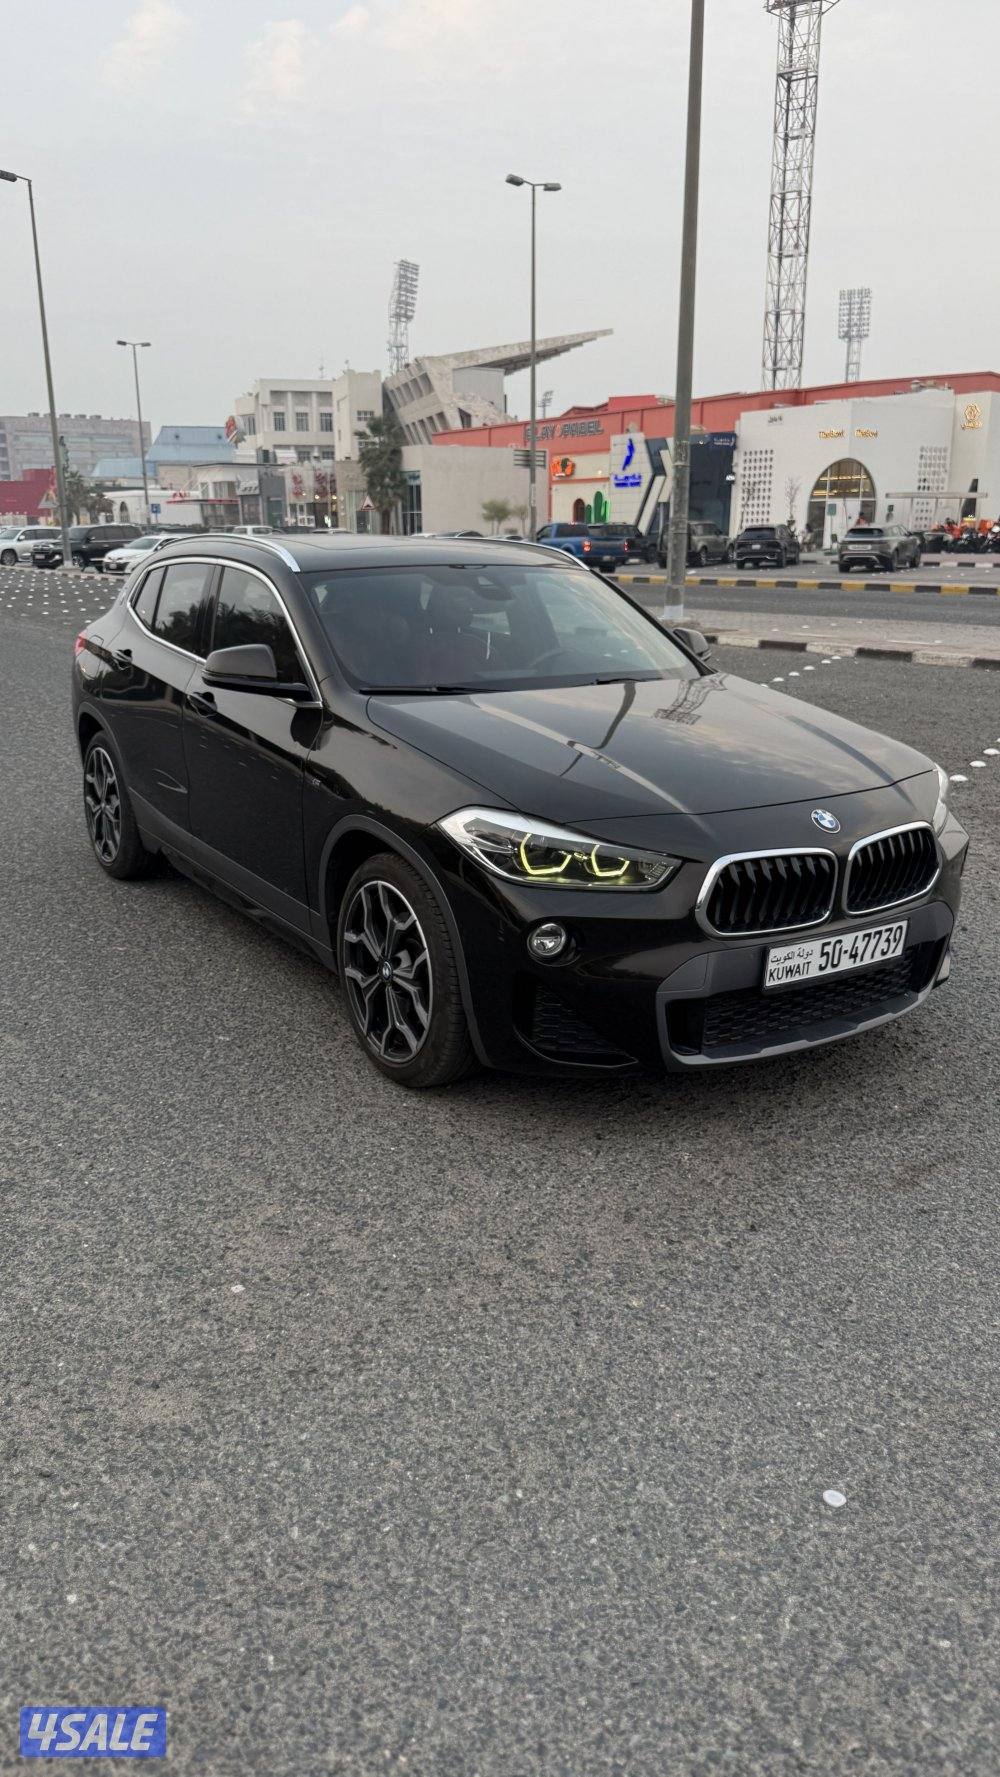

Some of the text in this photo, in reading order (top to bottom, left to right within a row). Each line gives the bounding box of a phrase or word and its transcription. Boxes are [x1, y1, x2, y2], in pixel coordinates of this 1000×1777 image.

[770, 947, 814, 965] دولة الكويت
[818, 925, 903, 972] 50-47739
[768, 961, 812, 983] KUWAIT
